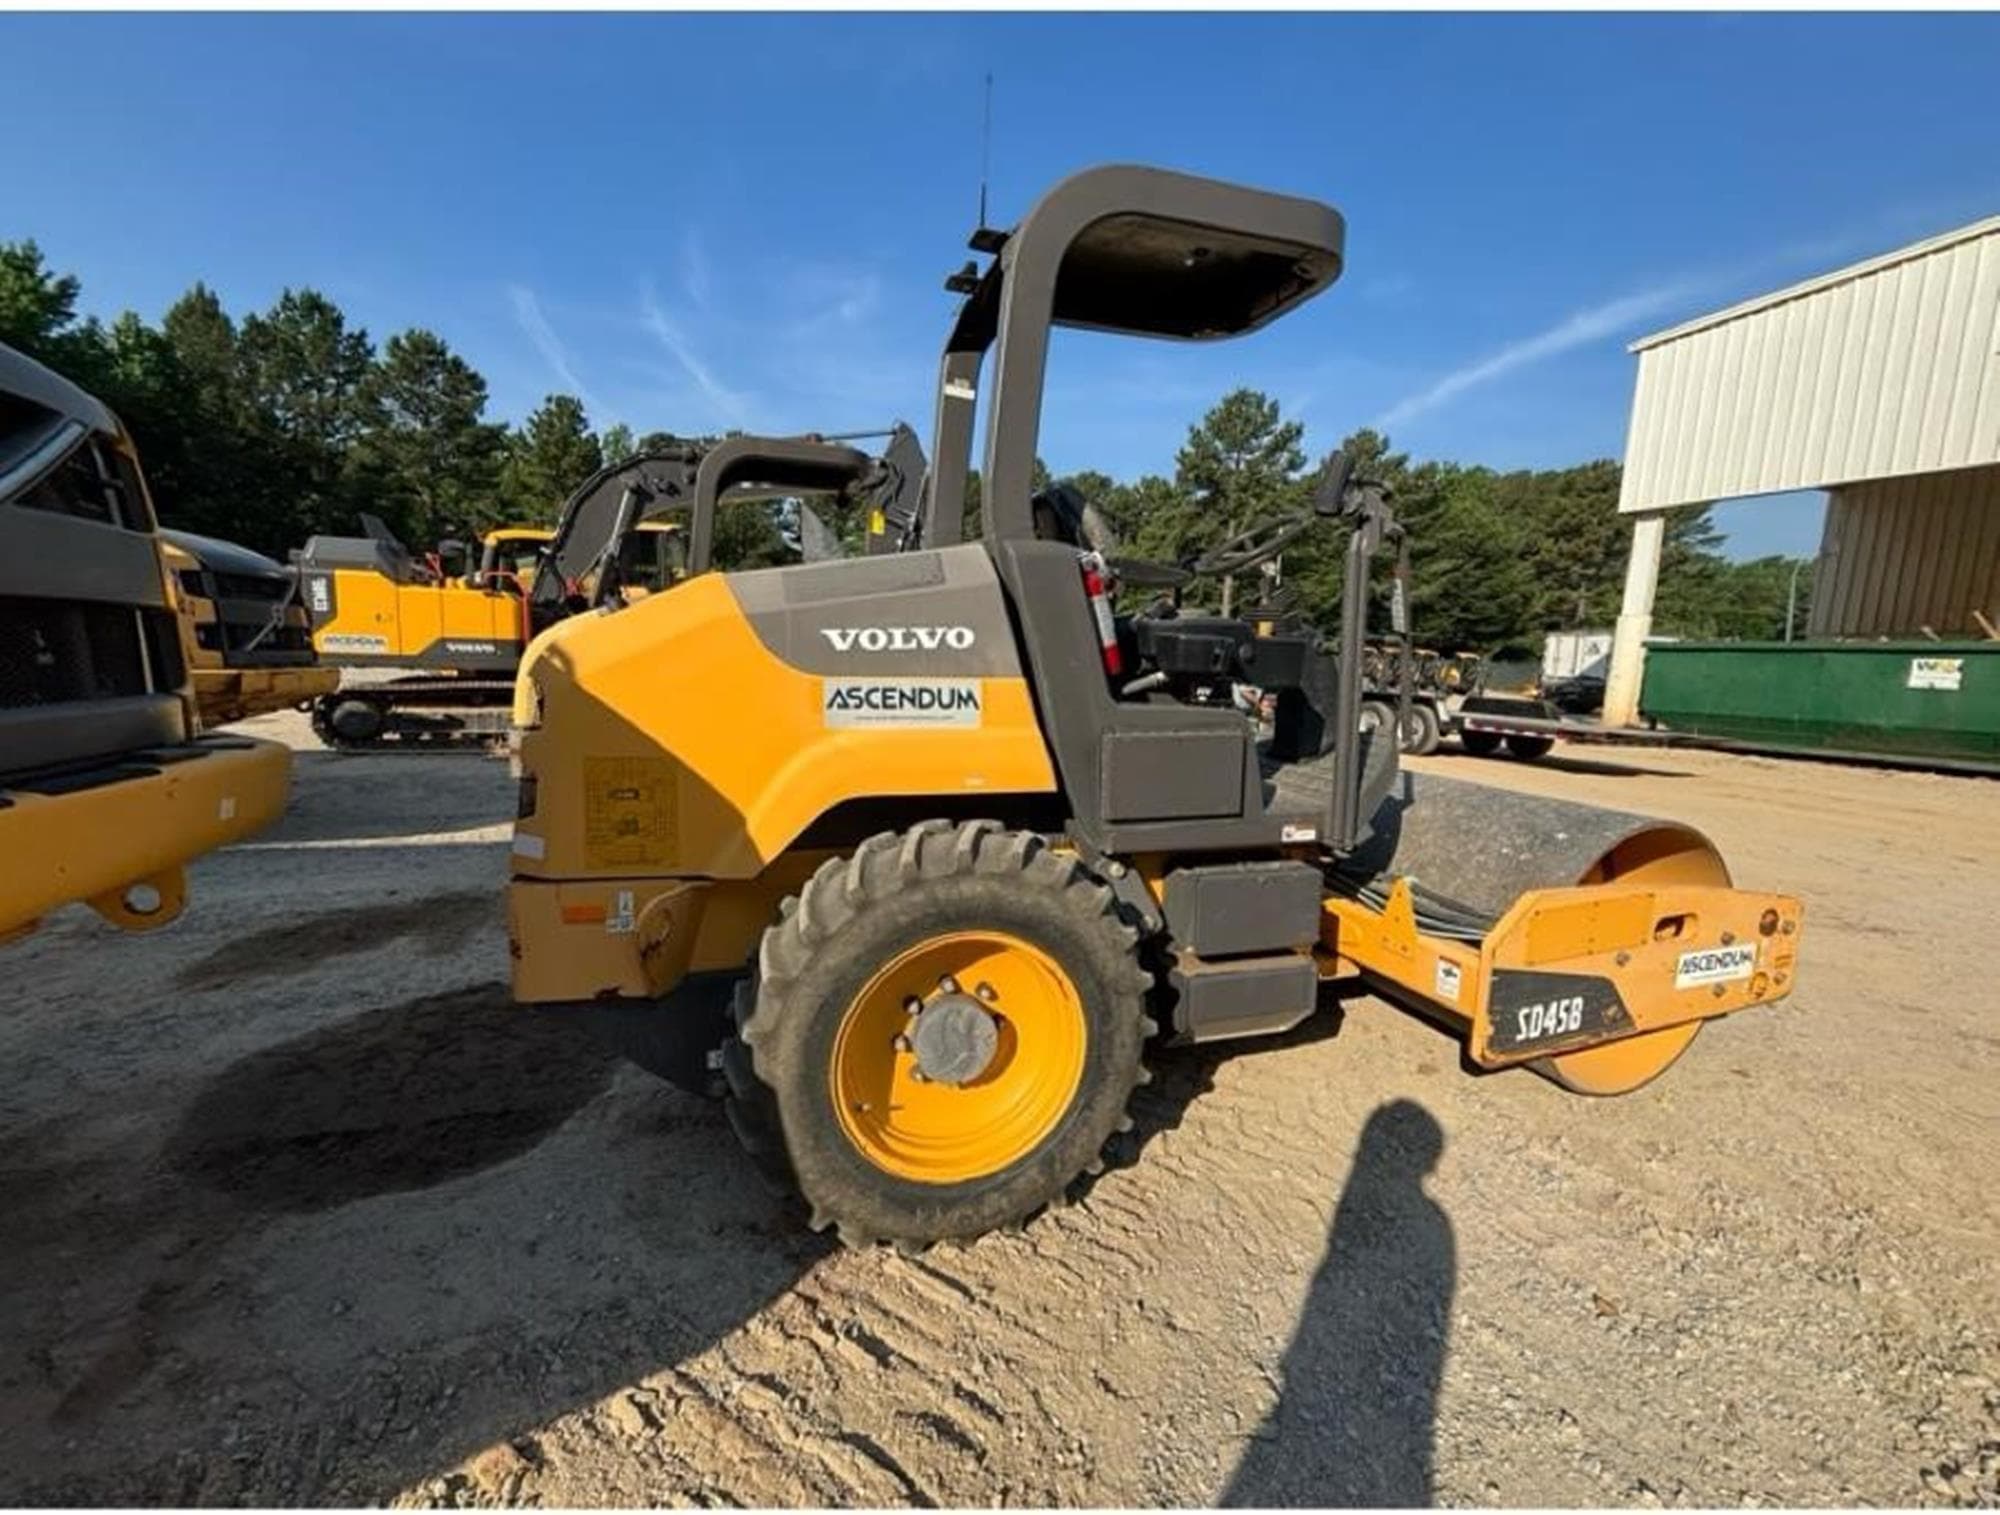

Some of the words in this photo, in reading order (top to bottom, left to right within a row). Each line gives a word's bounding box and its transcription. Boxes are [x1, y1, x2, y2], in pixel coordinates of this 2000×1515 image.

[821, 627, 975, 651] VOLVO
[826, 687, 980, 710] ASCENDUM
[1680, 949, 1754, 974] ASCENDUM
[1516, 997, 1583, 1041] SD45B
